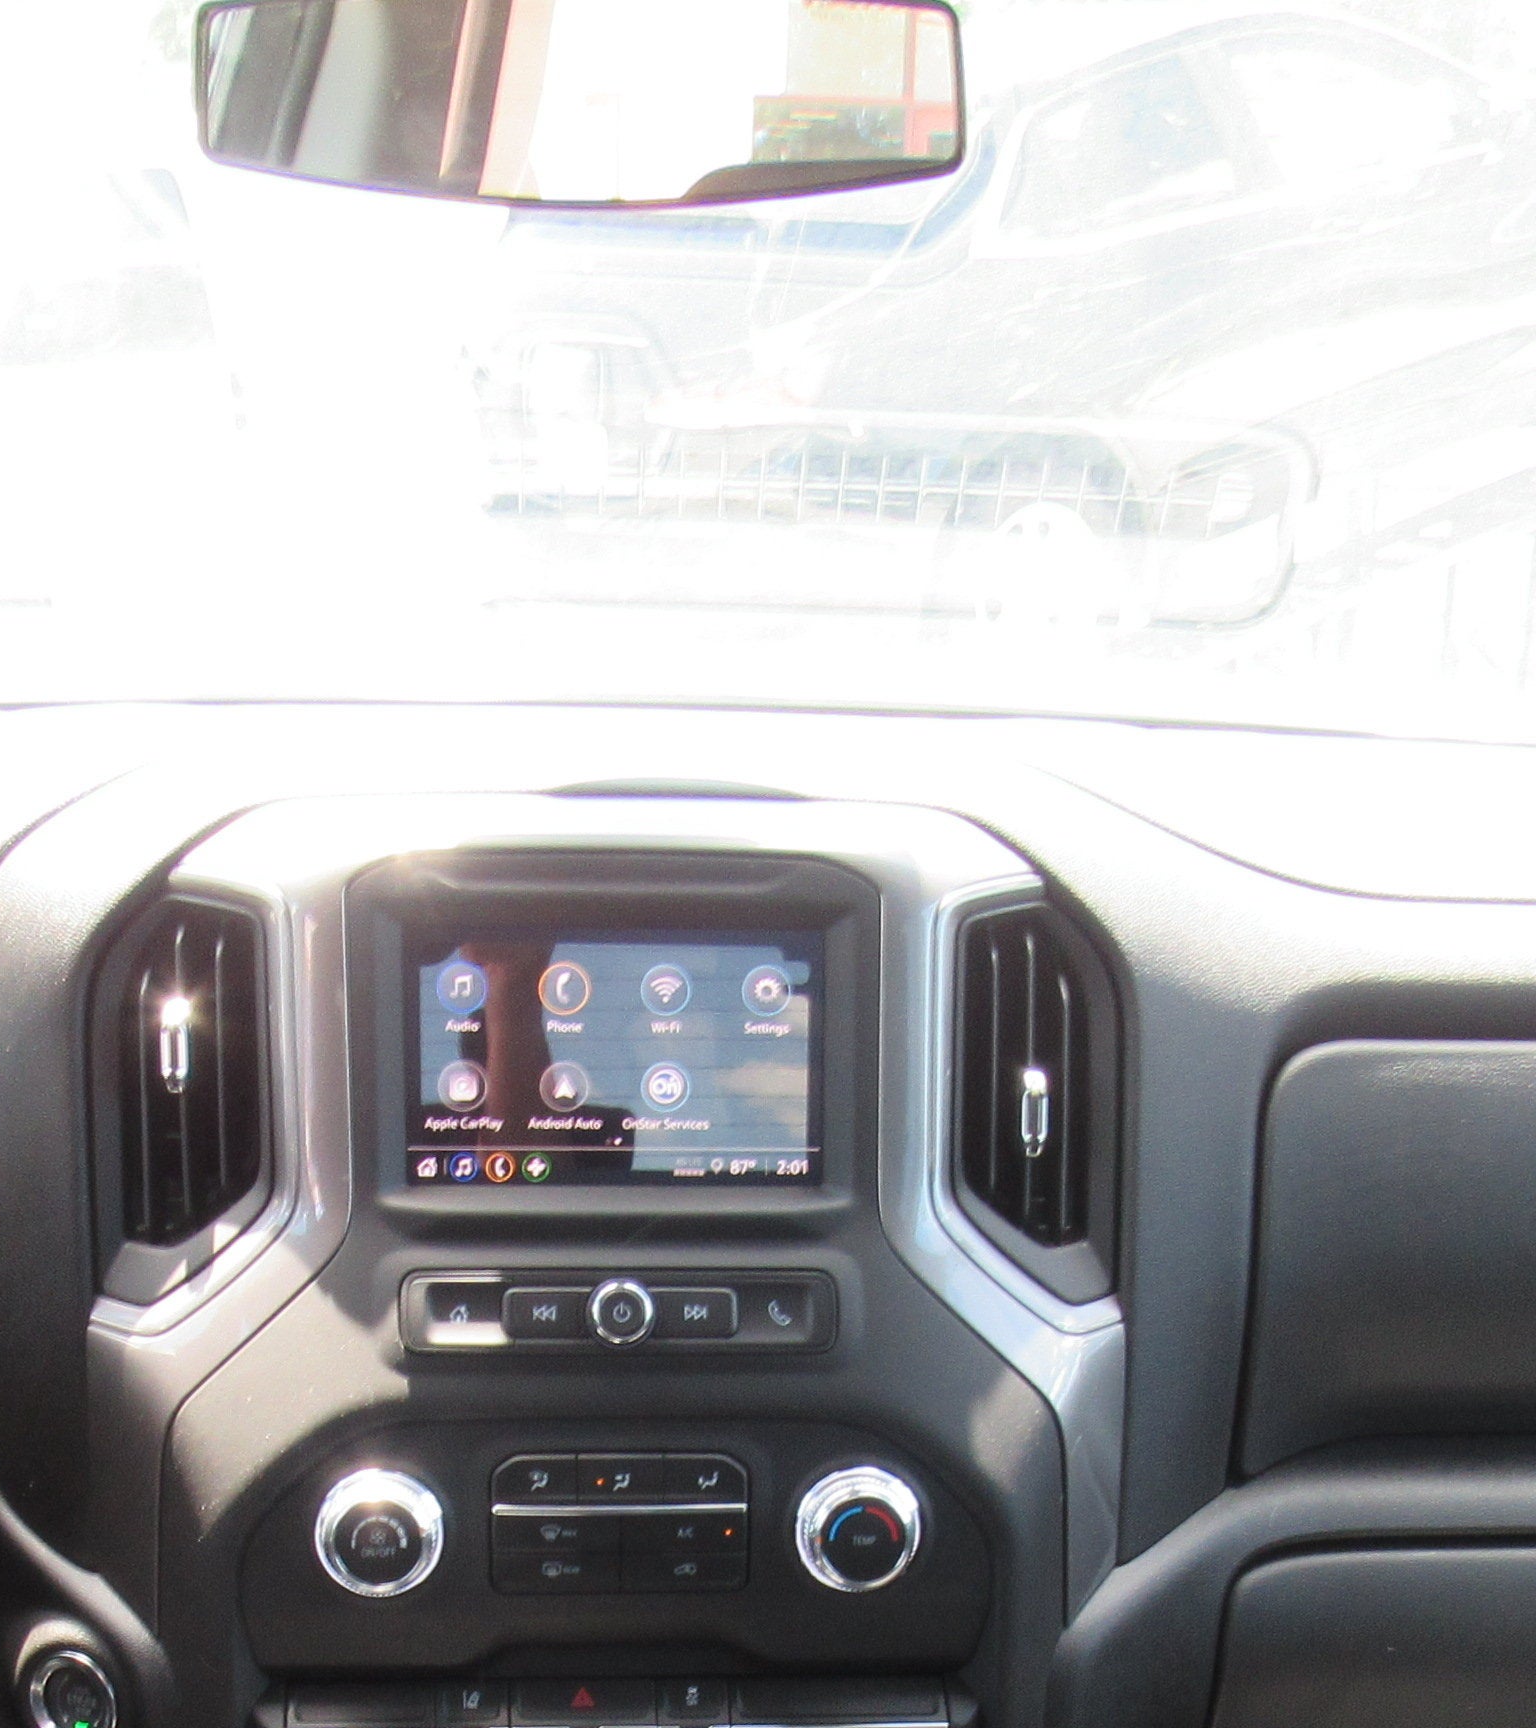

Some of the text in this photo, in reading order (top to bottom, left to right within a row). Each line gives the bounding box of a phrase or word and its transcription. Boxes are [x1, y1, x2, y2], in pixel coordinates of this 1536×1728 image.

[445, 1019, 481, 1033] Audio
[546, 1019, 583, 1034] Phone
[651, 1021, 680, 1034] Wi-Fi
[743, 1021, 792, 1037] Settings
[423, 1116, 505, 1133] Apple CarPlay
[527, 1117, 603, 1131] Android Auto
[621, 1118, 710, 1132] OnStar Services
[775, 1159, 809, 1177] 2:01
